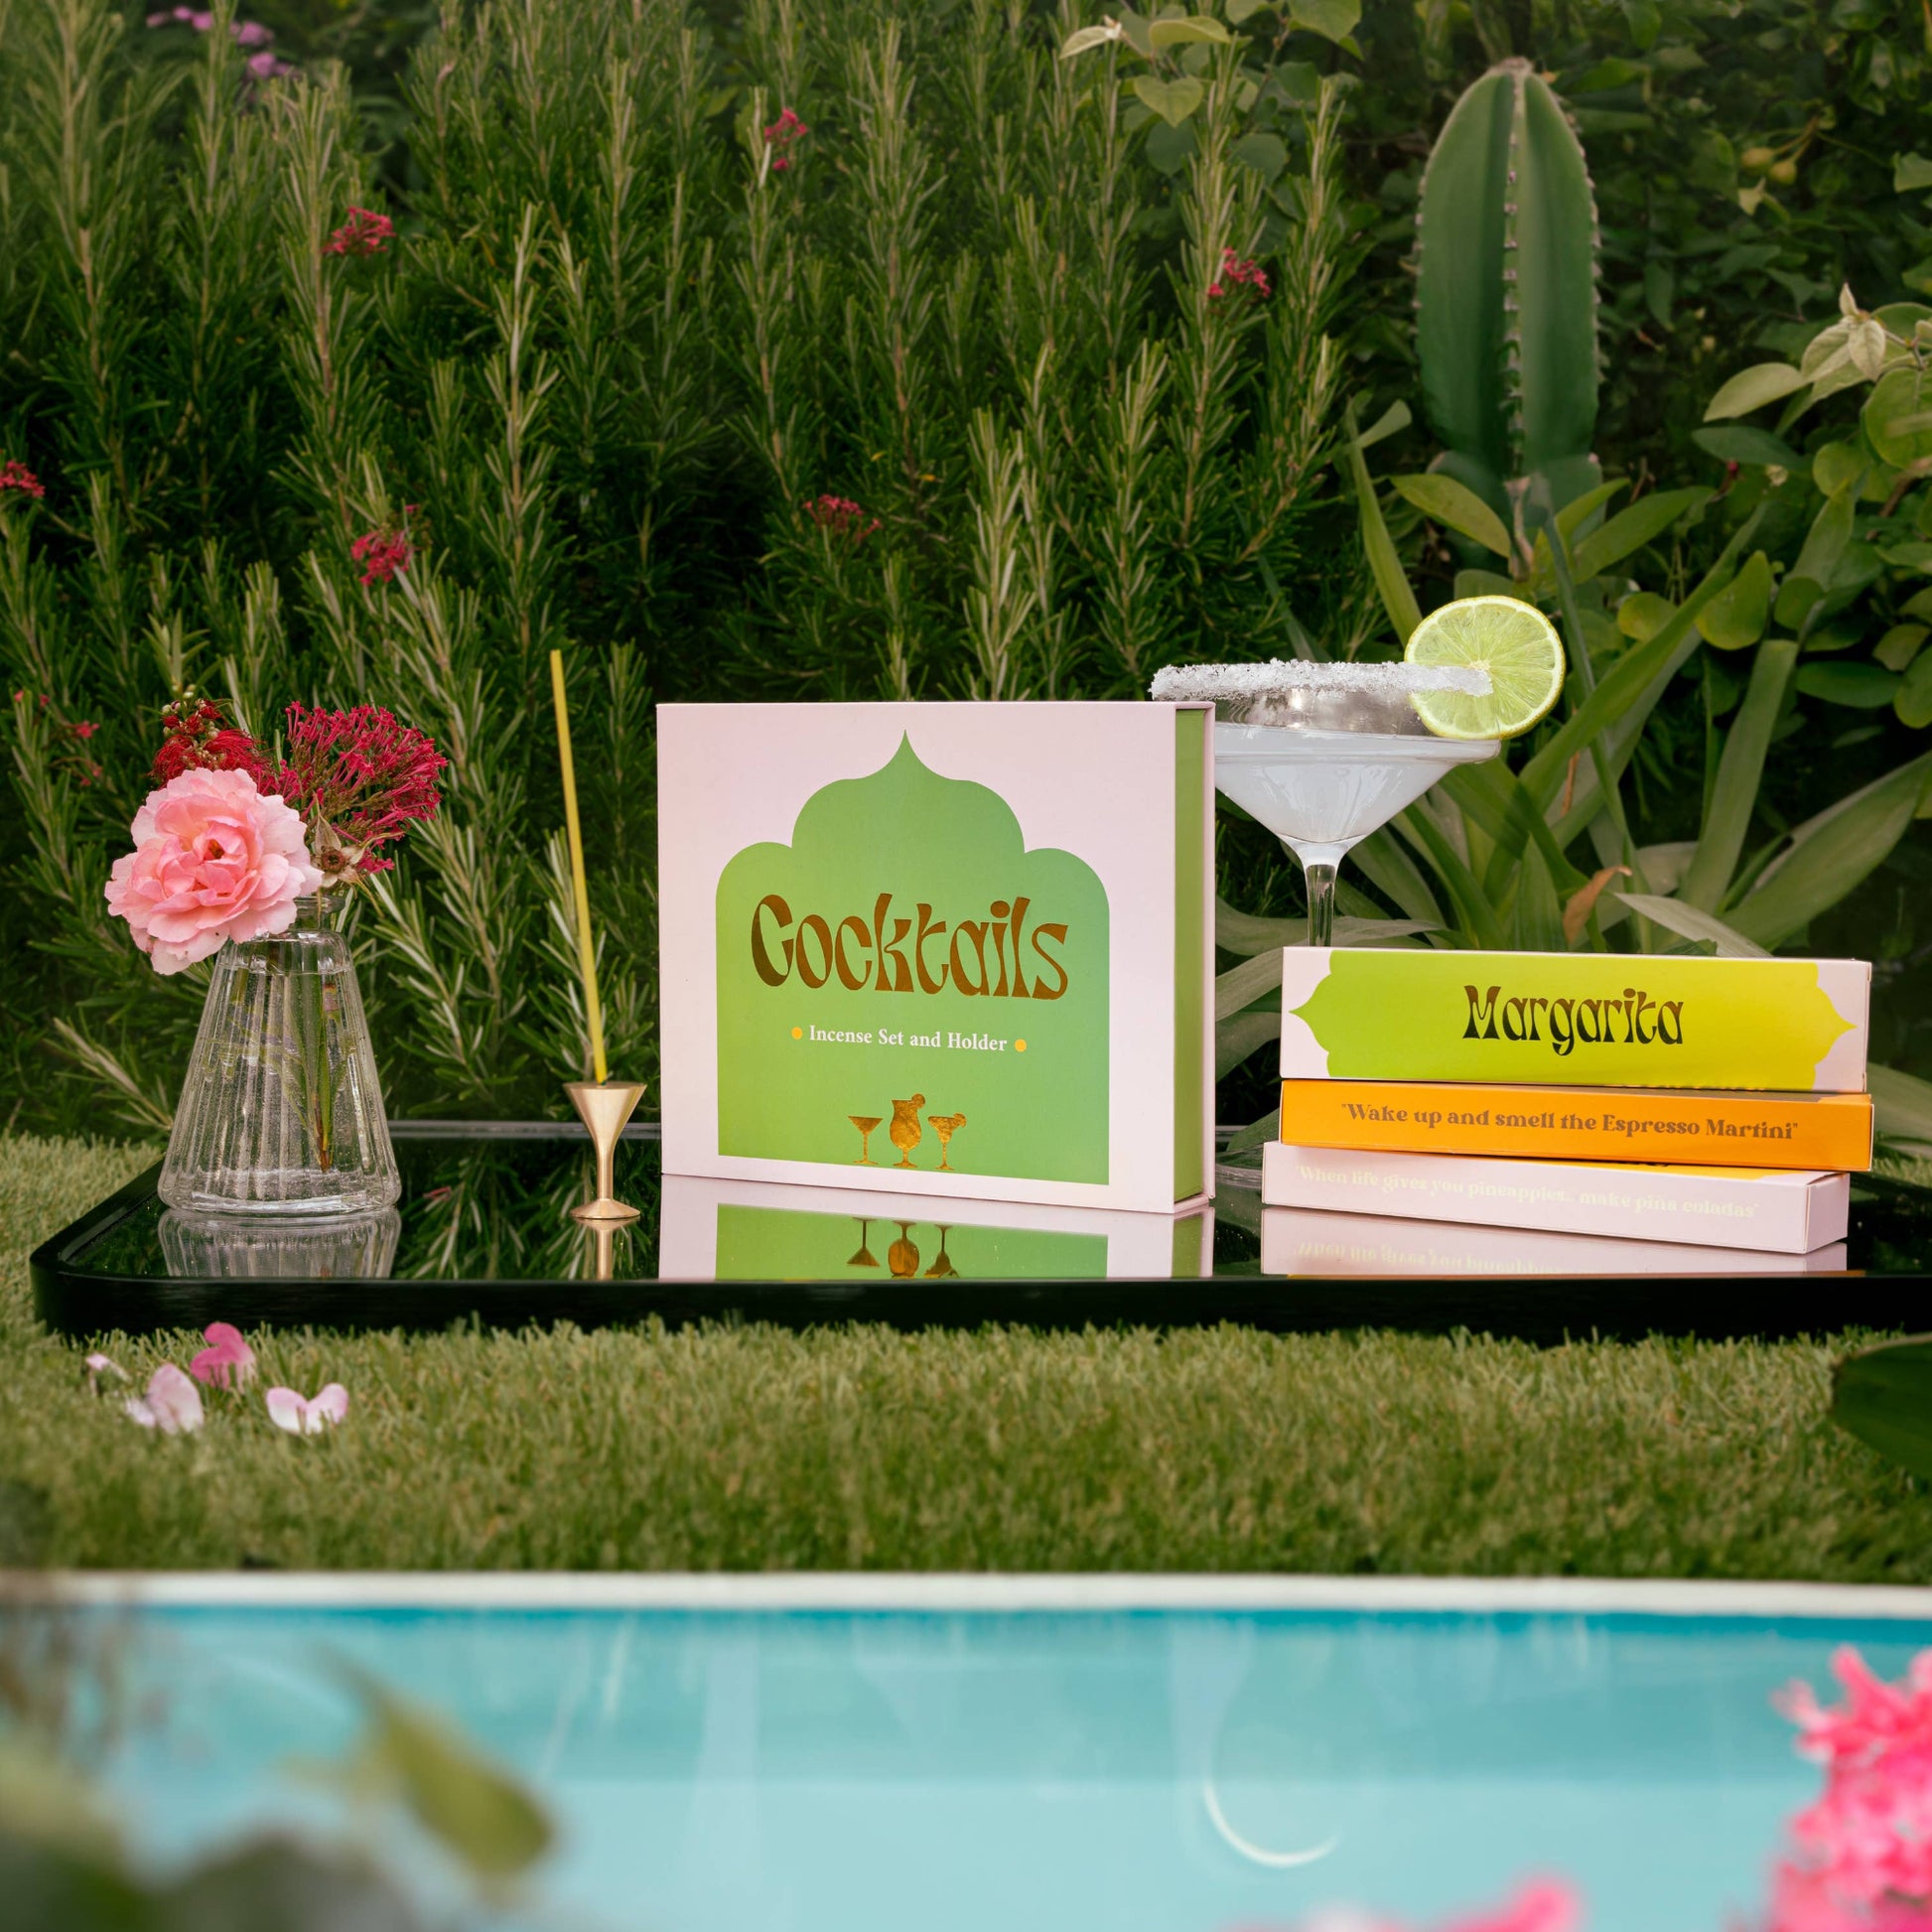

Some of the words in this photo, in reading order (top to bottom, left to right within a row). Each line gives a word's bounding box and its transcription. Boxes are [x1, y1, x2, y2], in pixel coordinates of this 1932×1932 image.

[752, 893, 1068, 1000] Cocktails
[809, 1025, 872, 1043] Incense
[879, 1029, 903, 1045] Set
[910, 1032, 941, 1047] and
[947, 1033, 1007, 1050] Holder
[1462, 985, 1684, 1056] Margarita
[1341, 1103, 1408, 1122] "Wake
[1414, 1110, 1442, 1129] up
[1448, 1110, 1489, 1125] and
[1495, 1112, 1555, 1129] smell
[1560, 1113, 1596, 1130] the
[1602, 1114, 1700, 1138] Espresso
[1706, 1119, 1798, 1139] Martini"
[1351, 1170, 1378, 1186] life
[1381, 1173, 1427, 1193] gives
[1430, 1177, 1463, 1197] you
[1580, 1191, 1630, 1208] make
